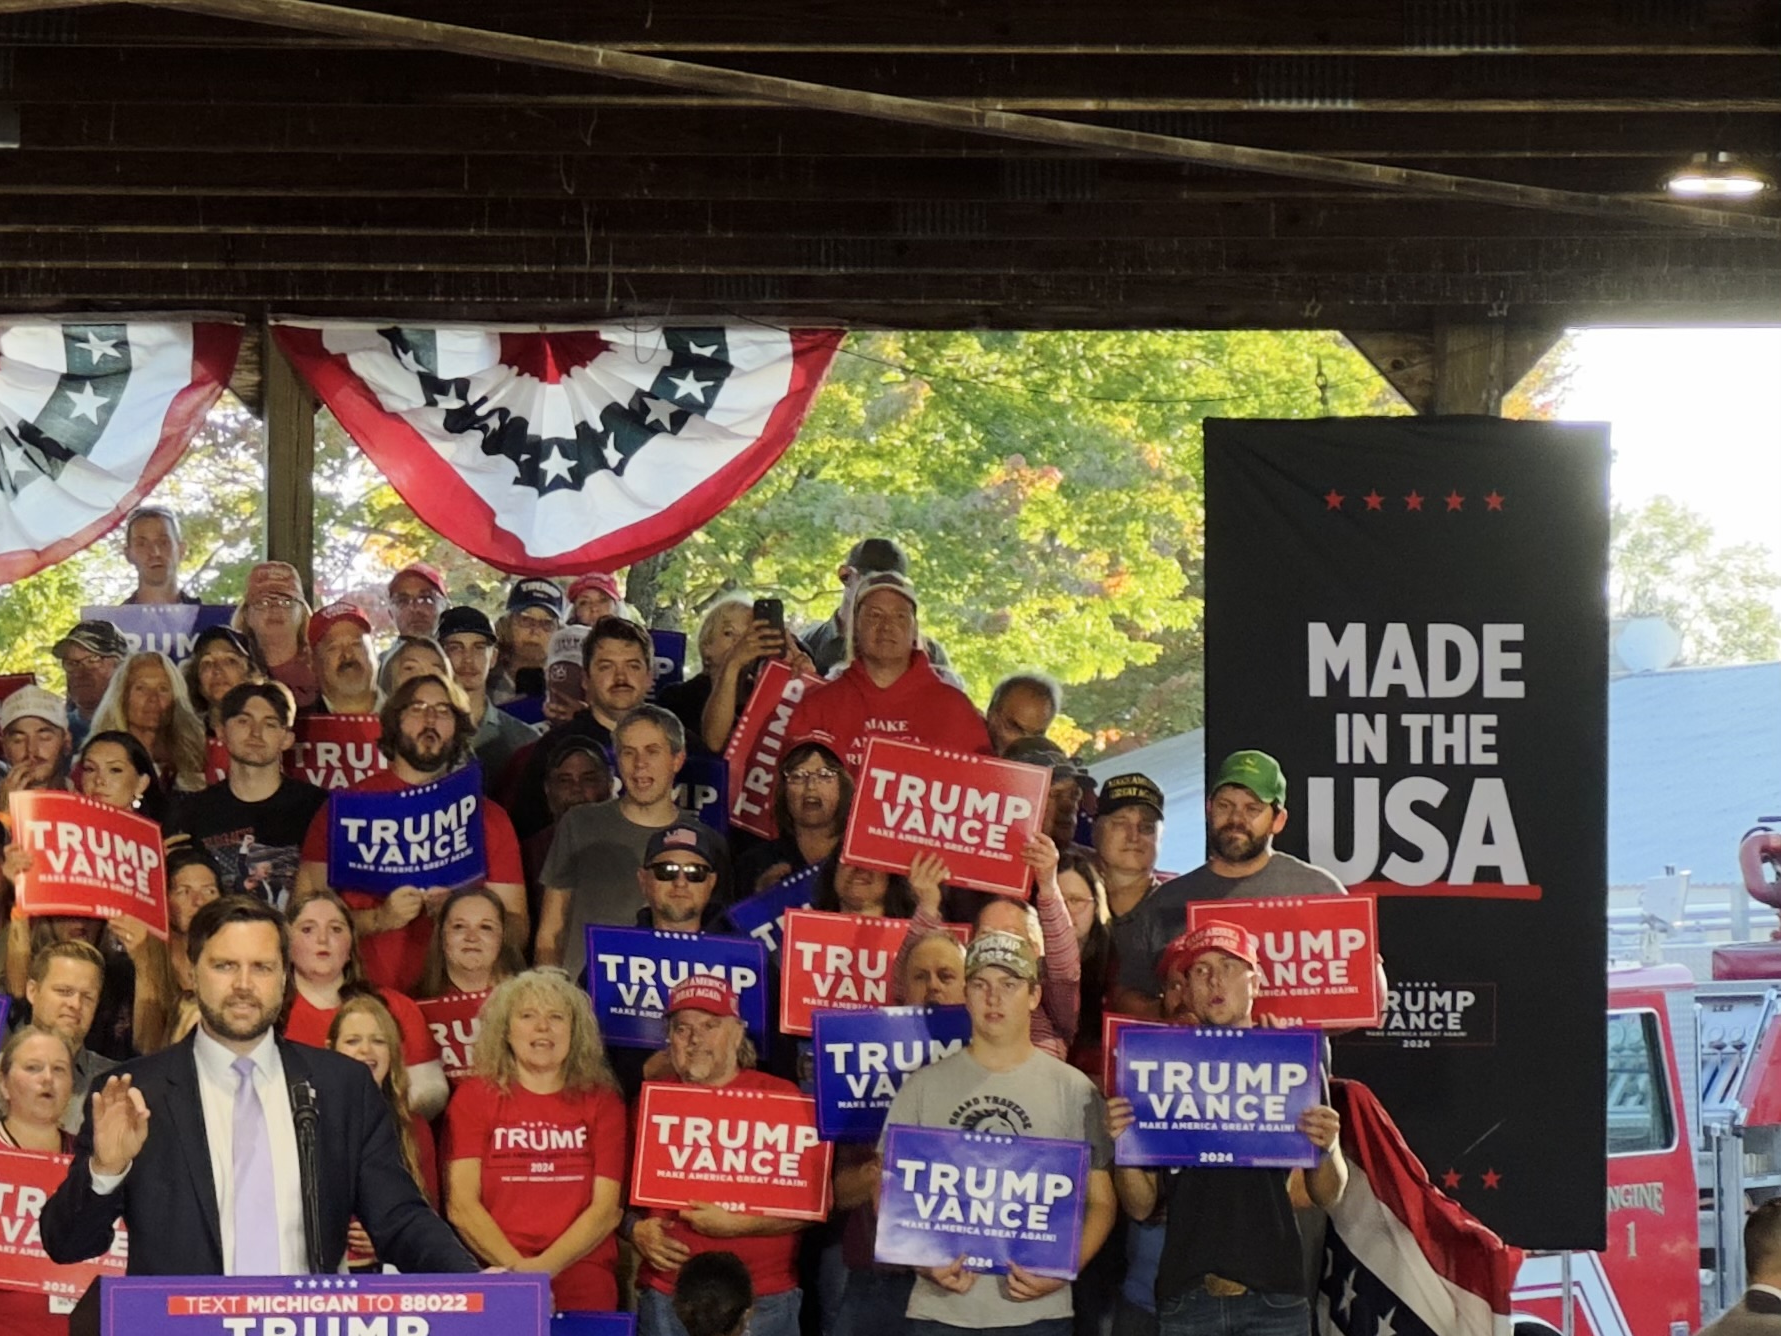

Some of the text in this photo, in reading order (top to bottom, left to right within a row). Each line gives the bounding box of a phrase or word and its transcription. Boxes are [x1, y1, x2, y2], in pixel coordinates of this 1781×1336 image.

[1308, 622, 1525, 698] MADE
[1336, 713, 1498, 764] IN THE
[870, 768, 1032, 826] TRUMP
[340, 795, 476, 844] TRUMP
[882, 802, 1008, 850] VANCE
[1308, 776, 1530, 886] USA
[25, 821, 159, 870] TRUMP
[357, 827, 468, 865] VANCE
[46, 850, 150, 894] VANCE
[795, 941, 888, 979] TRU
[974, 938, 1020, 952] TRUMP
[978, 951, 1012, 963] 2024
[1251, 928, 1366, 961] UMP
[812, 973, 887, 1003] VAN
[1290, 987, 1322, 996] GREAT
[1381, 990, 1476, 1012] RUMP
[825, 1038, 963, 1074] TRUM
[1402, 1039, 1431, 1048] 2024
[1129, 1060, 1308, 1095] TRUMP
[948, 1095, 1033, 1130] GRAND TRAVERSE
[1148, 1093, 1286, 1121] VANCE
[651, 1114, 819, 1154] TRUMP
[1139, 1121, 1168, 1130] MAKE
[1171, 1121, 1218, 1131] AMERICA
[1221, 1122, 1255, 1131] GREAT
[530, 1162, 555, 1173] 2024
[668, 1144, 801, 1177] VANCE
[1199, 1152, 1234, 1163] 2024
[896, 1159, 1073, 1205] TRUMP
[1607, 1182, 1665, 1215] NGINE
[914, 1193, 1050, 1231] VANCE
[1626, 1221, 1637, 1260] 1
[963, 1256, 993, 1268] 024
[43, 1281, 75, 1293] 2024
[185, 1294, 468, 1314] TEXT MICHIGAN TO 88022
